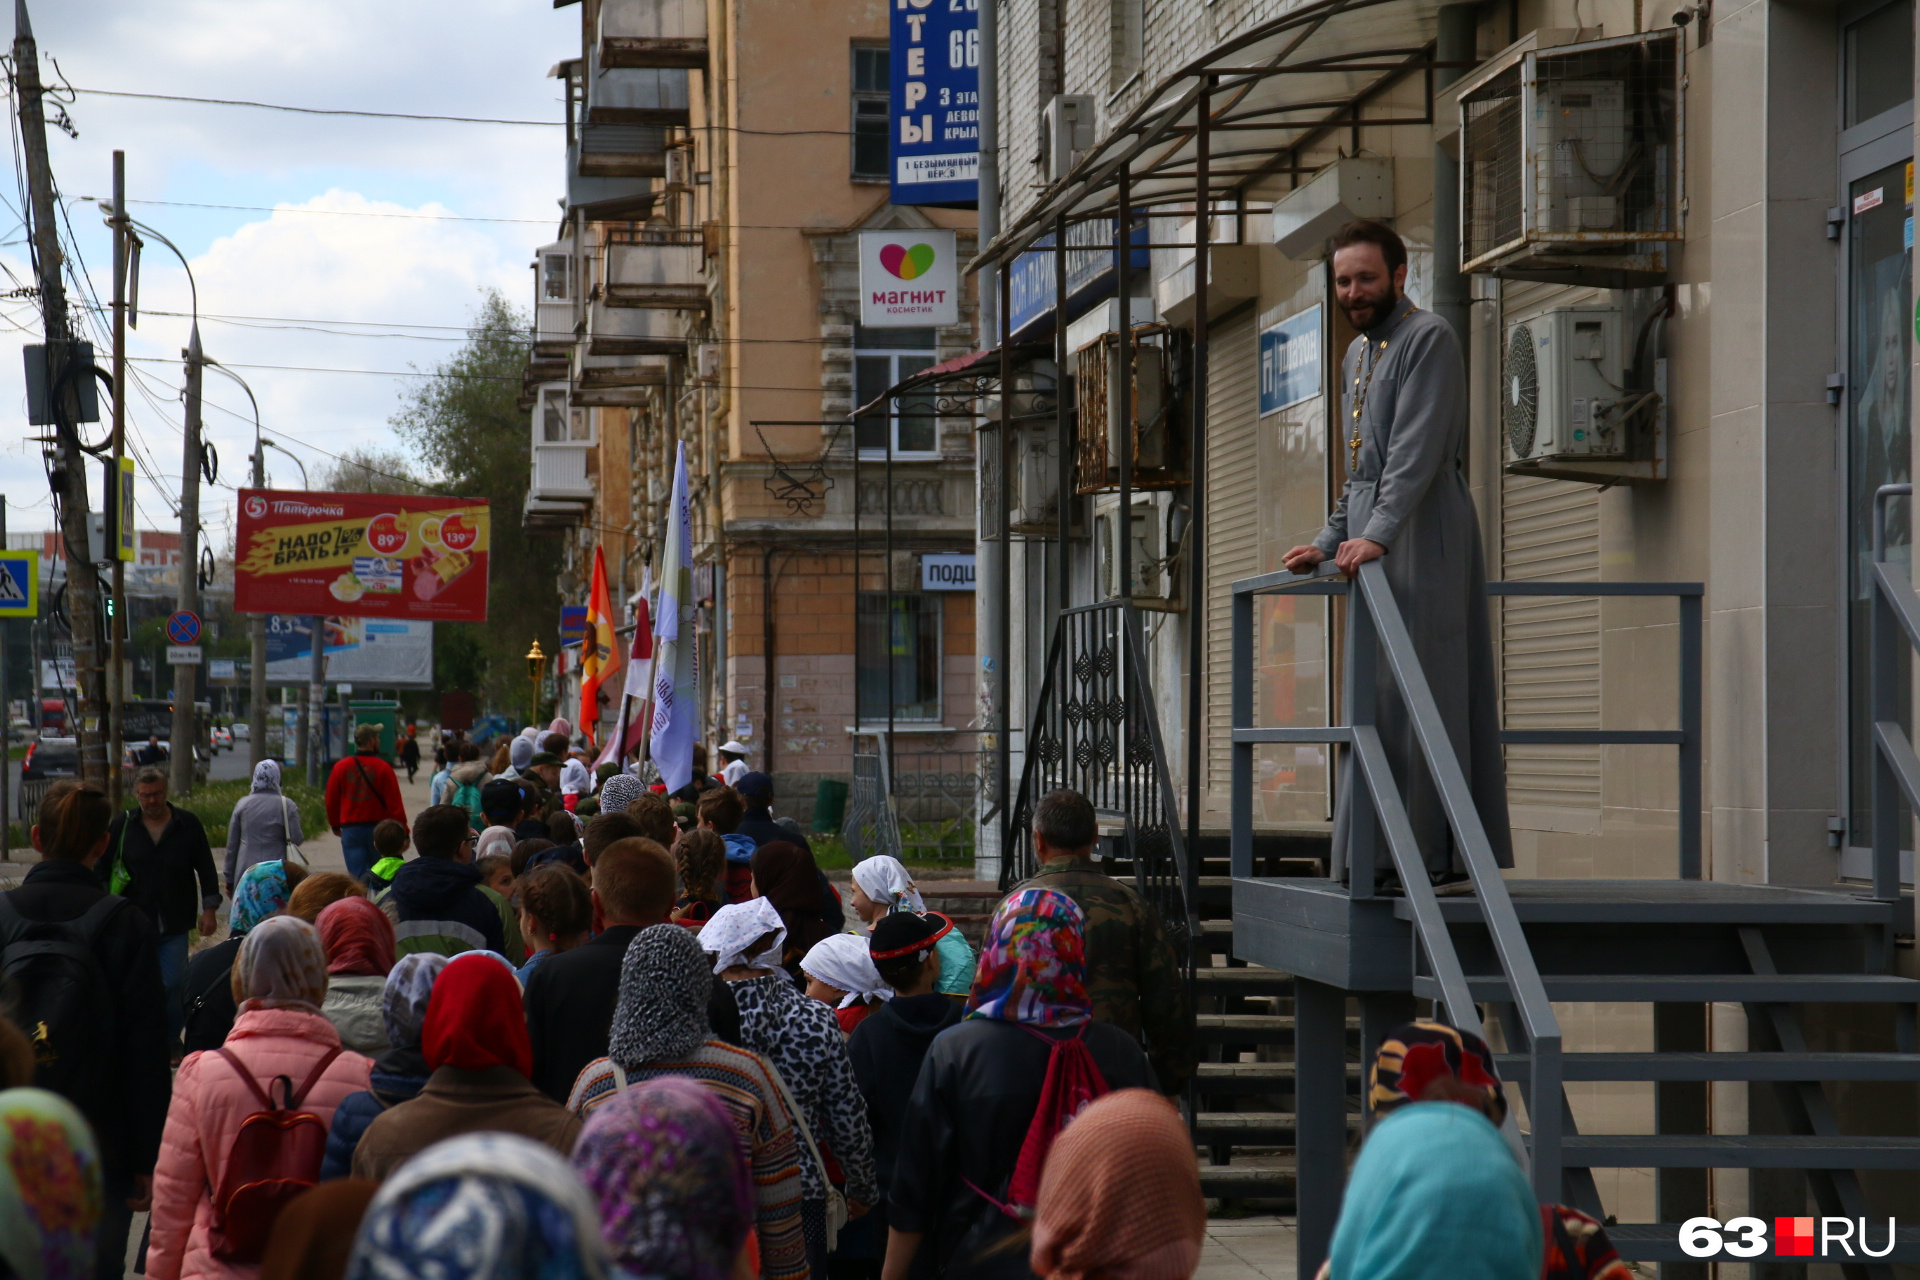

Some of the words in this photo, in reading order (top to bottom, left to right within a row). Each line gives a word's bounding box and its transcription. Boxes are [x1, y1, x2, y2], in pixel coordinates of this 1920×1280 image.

[940, 87, 950, 105] 3
[913, 156, 978, 169] БЕЗЫМЯННЫЙ
[279, 531, 331, 550] НАДО
[274, 546, 328, 565] БРАТЬ
